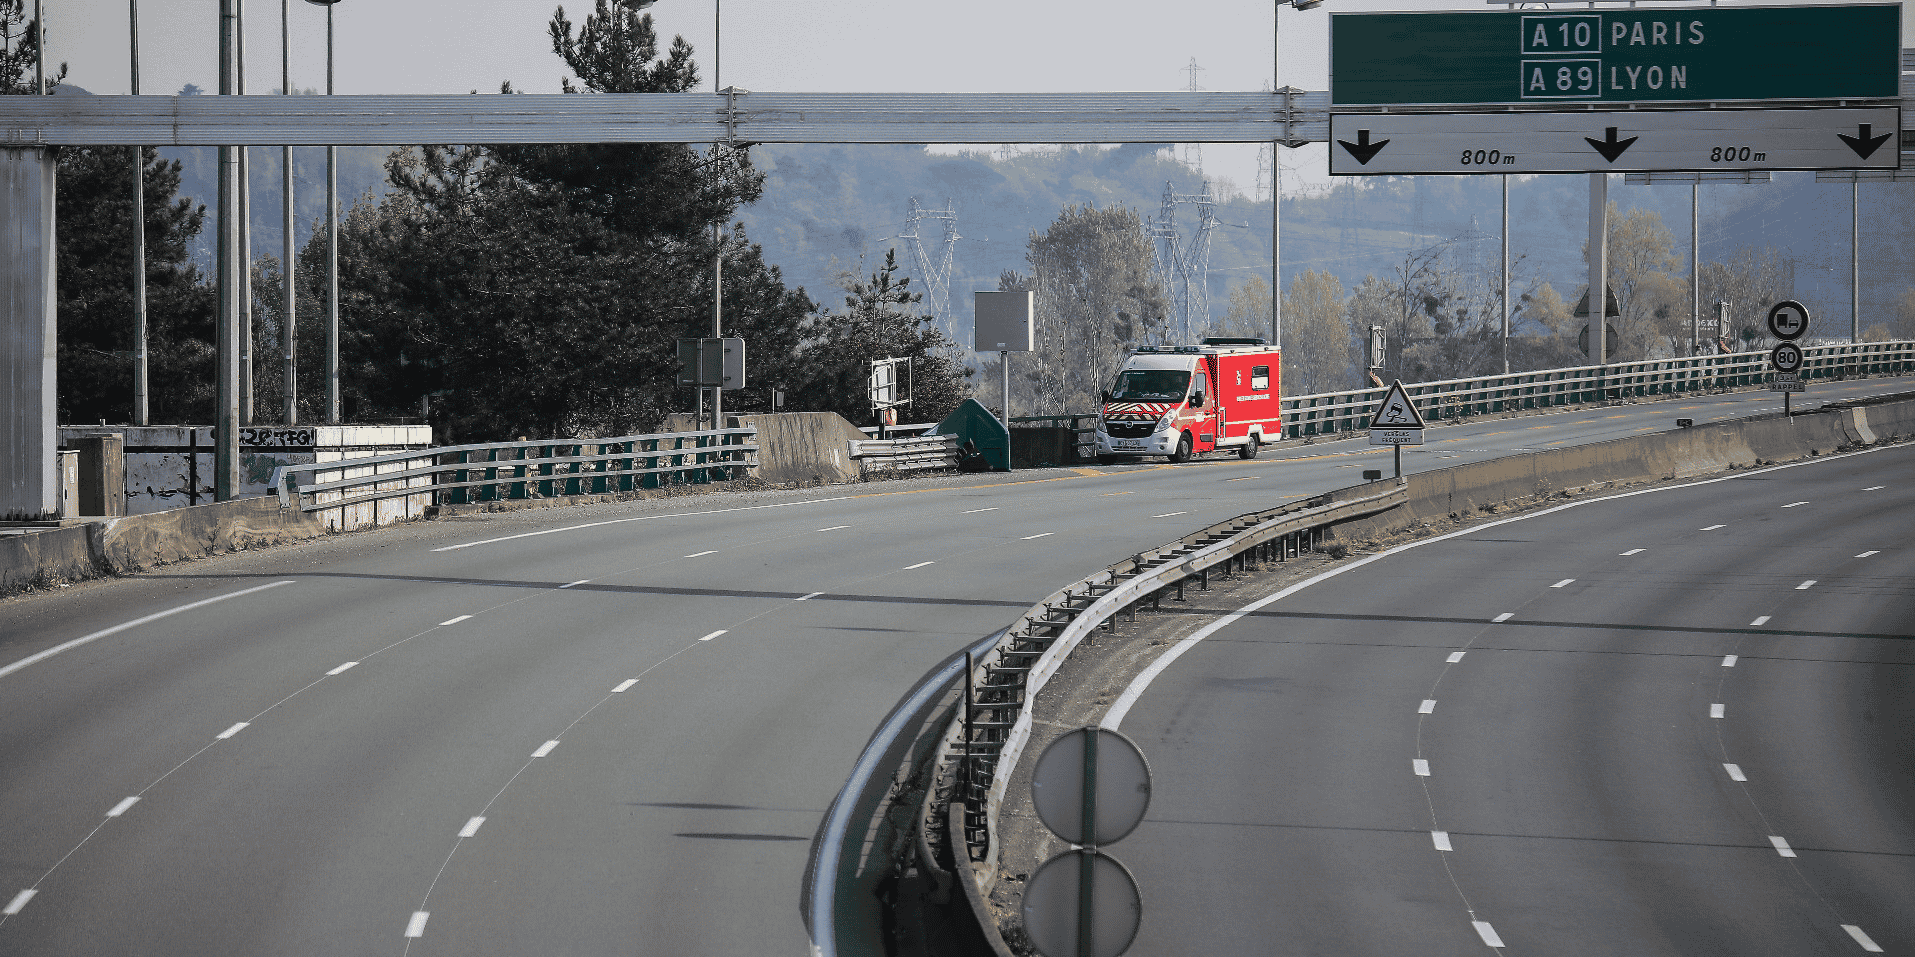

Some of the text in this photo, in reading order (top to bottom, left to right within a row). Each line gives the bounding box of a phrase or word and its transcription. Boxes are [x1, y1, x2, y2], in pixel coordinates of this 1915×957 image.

[1532, 20, 1705, 47] A 10 PARIS
[1529, 65, 1687, 91] A 89 LYON
[1778, 351, 1796, 364] 80
